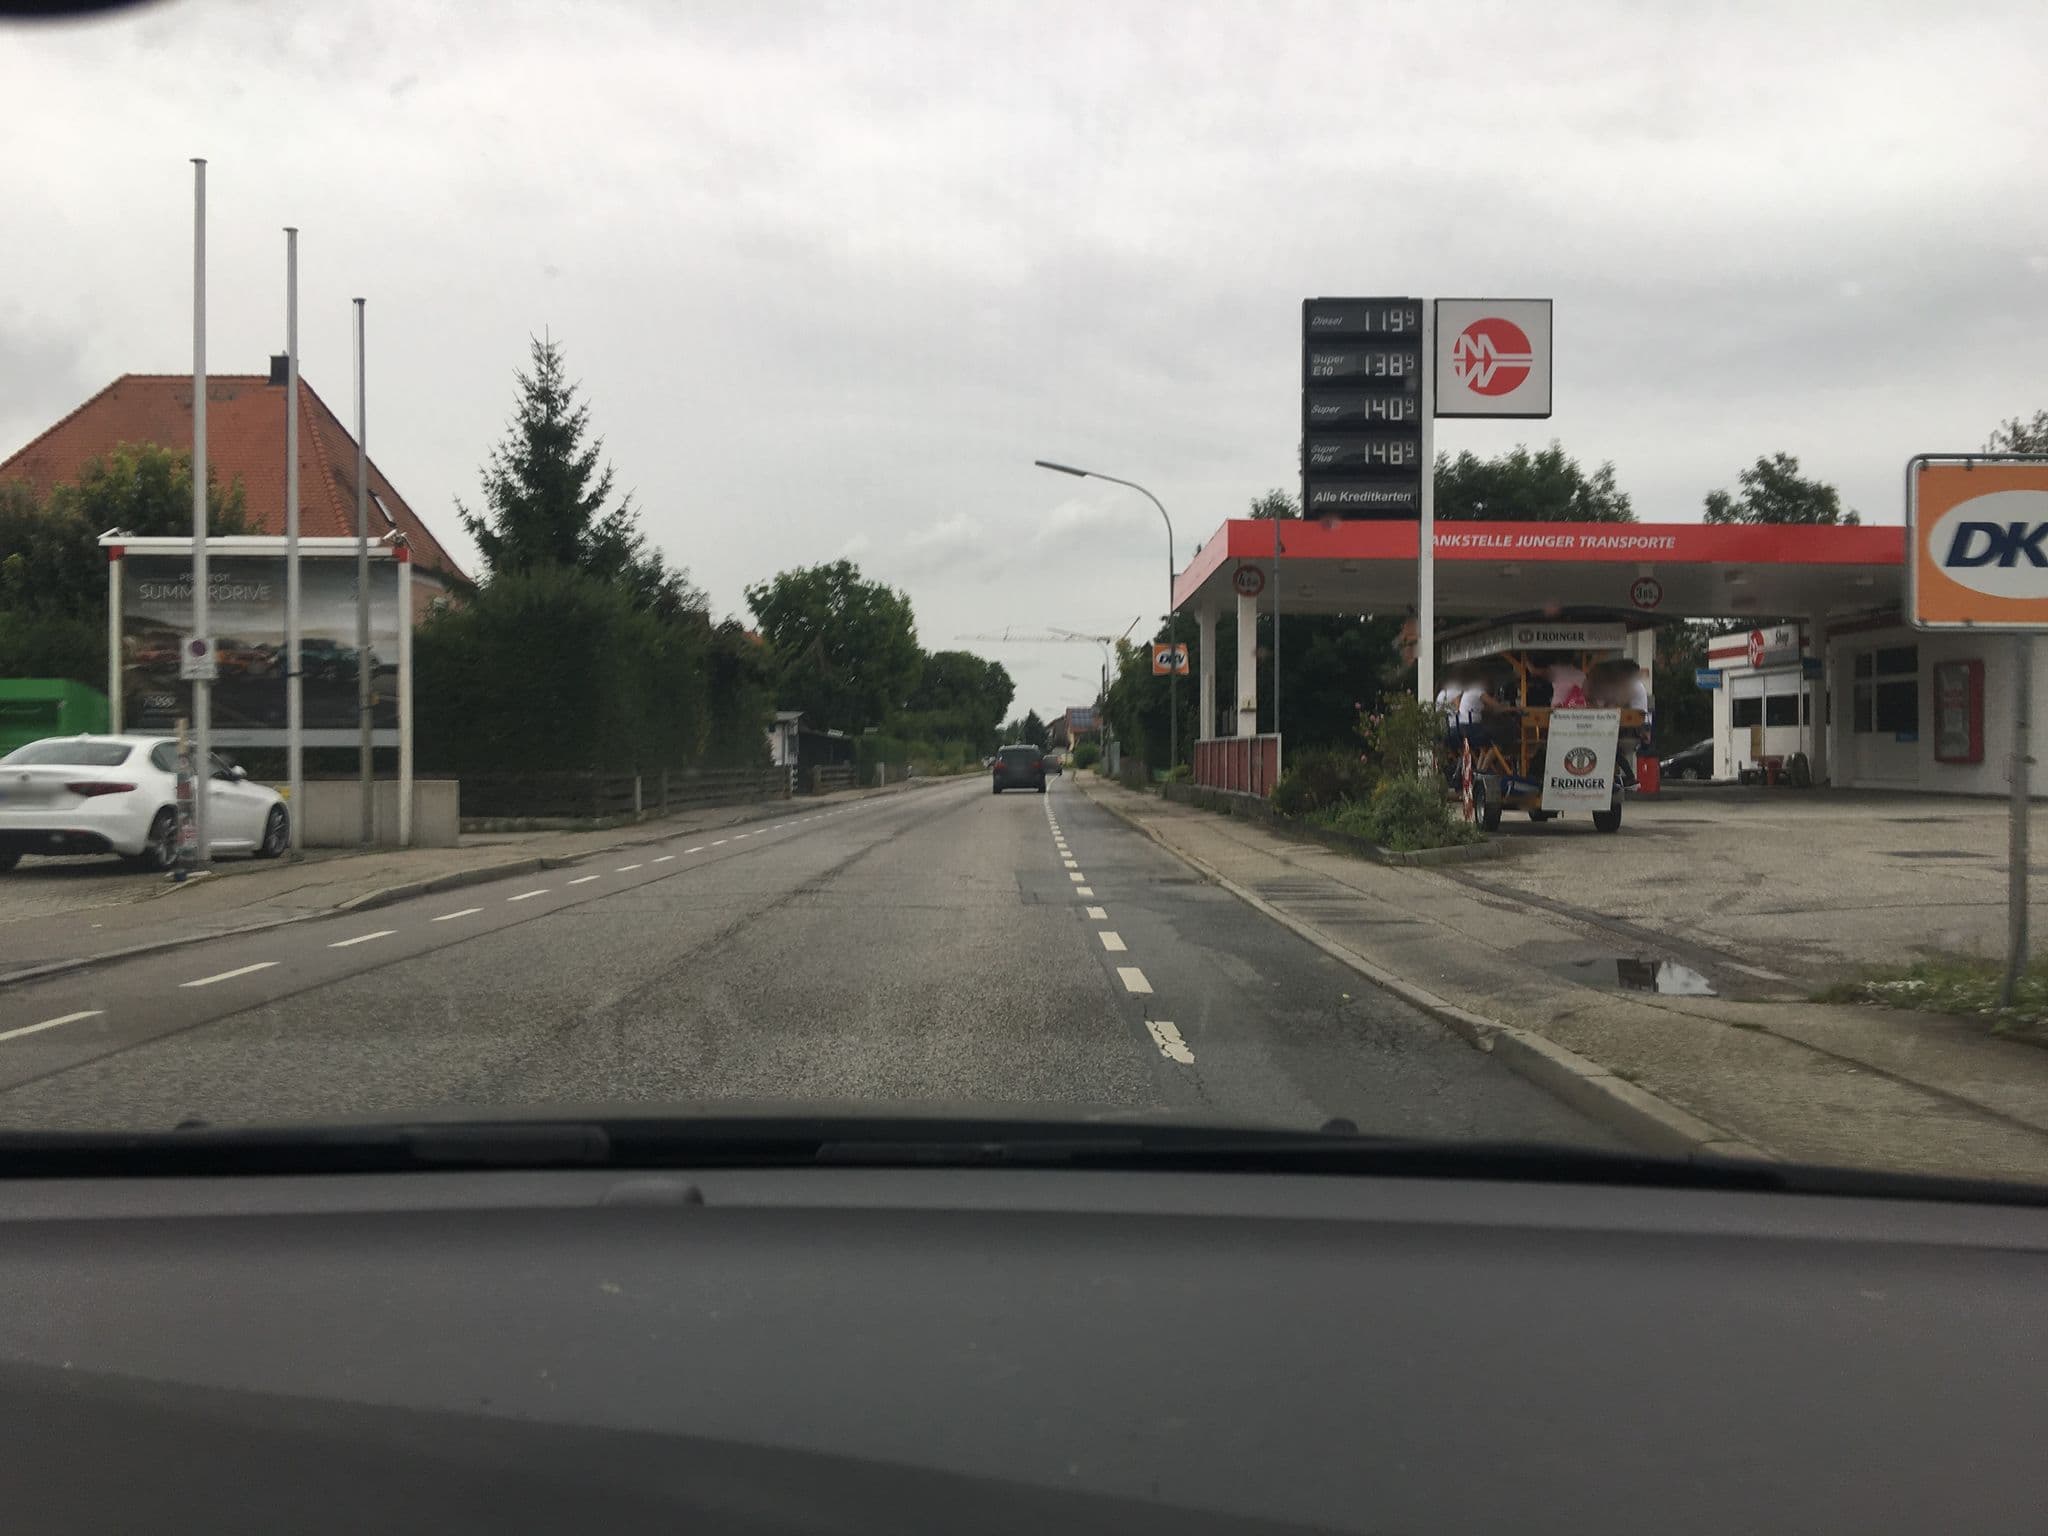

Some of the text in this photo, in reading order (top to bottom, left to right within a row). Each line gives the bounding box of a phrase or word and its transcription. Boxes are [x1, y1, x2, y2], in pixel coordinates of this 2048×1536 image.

[1311, 315, 1343, 326] Diesel
[1312, 354, 1344, 365] Super
[1312, 366, 1334, 376] E10
[1311, 404, 1341, 415] Super
[1311, 445, 1341, 455] Super
[1311, 453, 1333, 463] Plus
[1313, 491, 1411, 502] Alle Kreditkarten
[1432, 534, 1677, 549] ANKSTELLE JUNGER TRANSPORTE
[138, 583, 273, 601] SUMMRDRIVE
[1536, 631, 1585, 642] ERDINGER
[1550, 776, 1606, 789] ERDINGER
